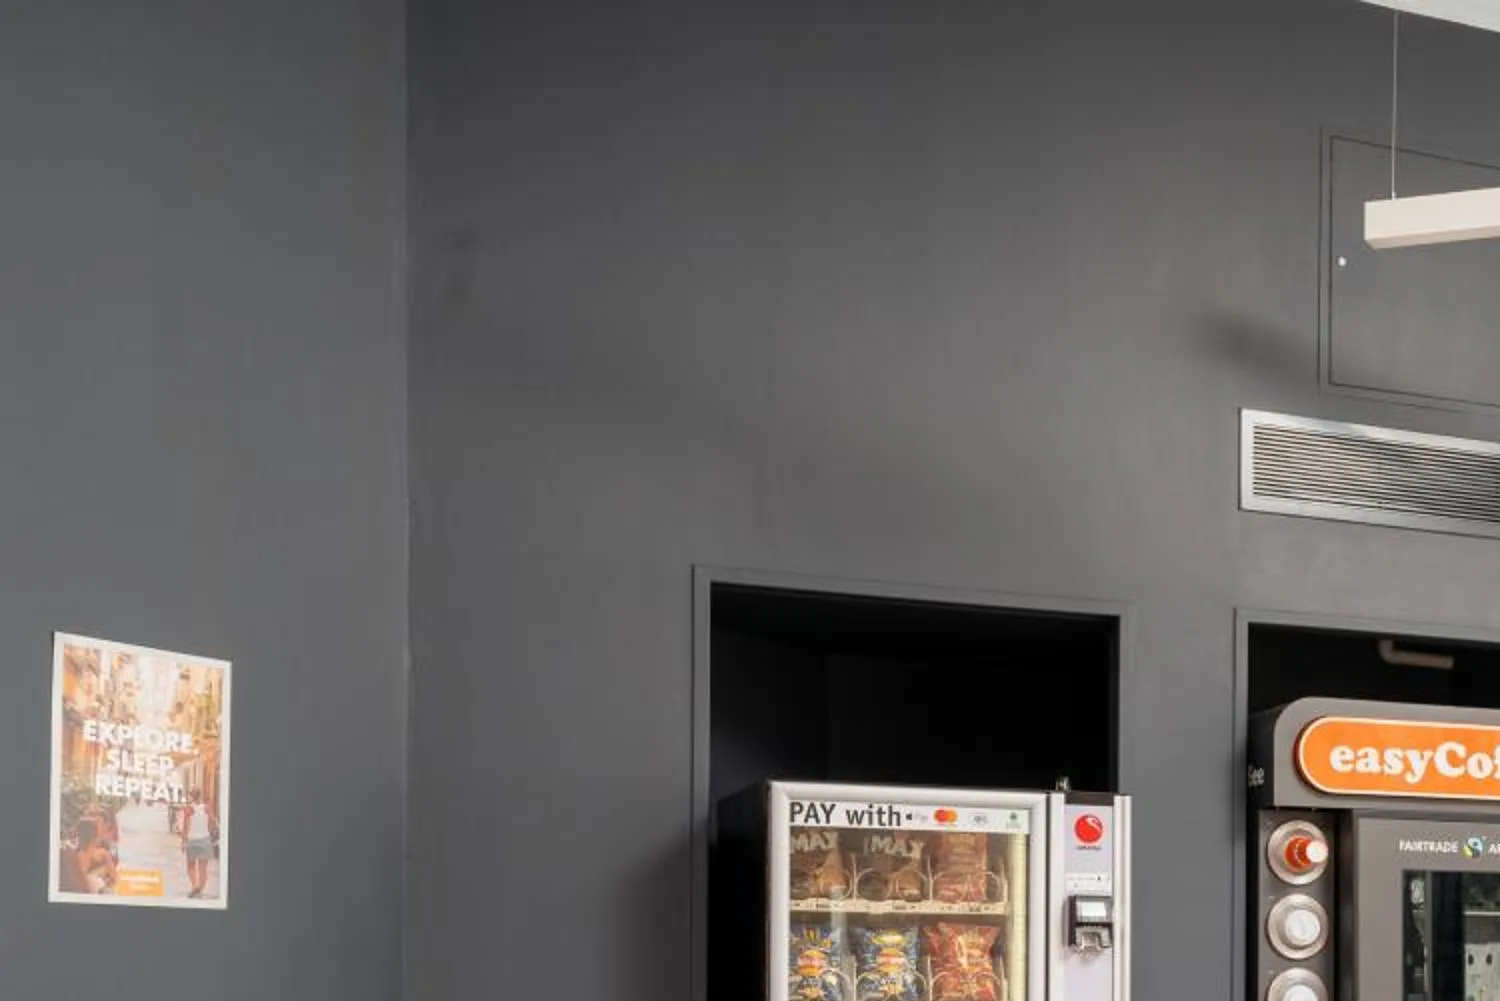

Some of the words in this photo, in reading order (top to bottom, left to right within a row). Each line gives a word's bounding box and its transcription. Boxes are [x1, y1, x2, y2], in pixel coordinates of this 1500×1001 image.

[95, 774, 187, 804] REPEAT.
[789, 801, 837, 825] PAY
[845, 803, 902, 827] with
[1399, 839, 1460, 854] FAIRTRADE
